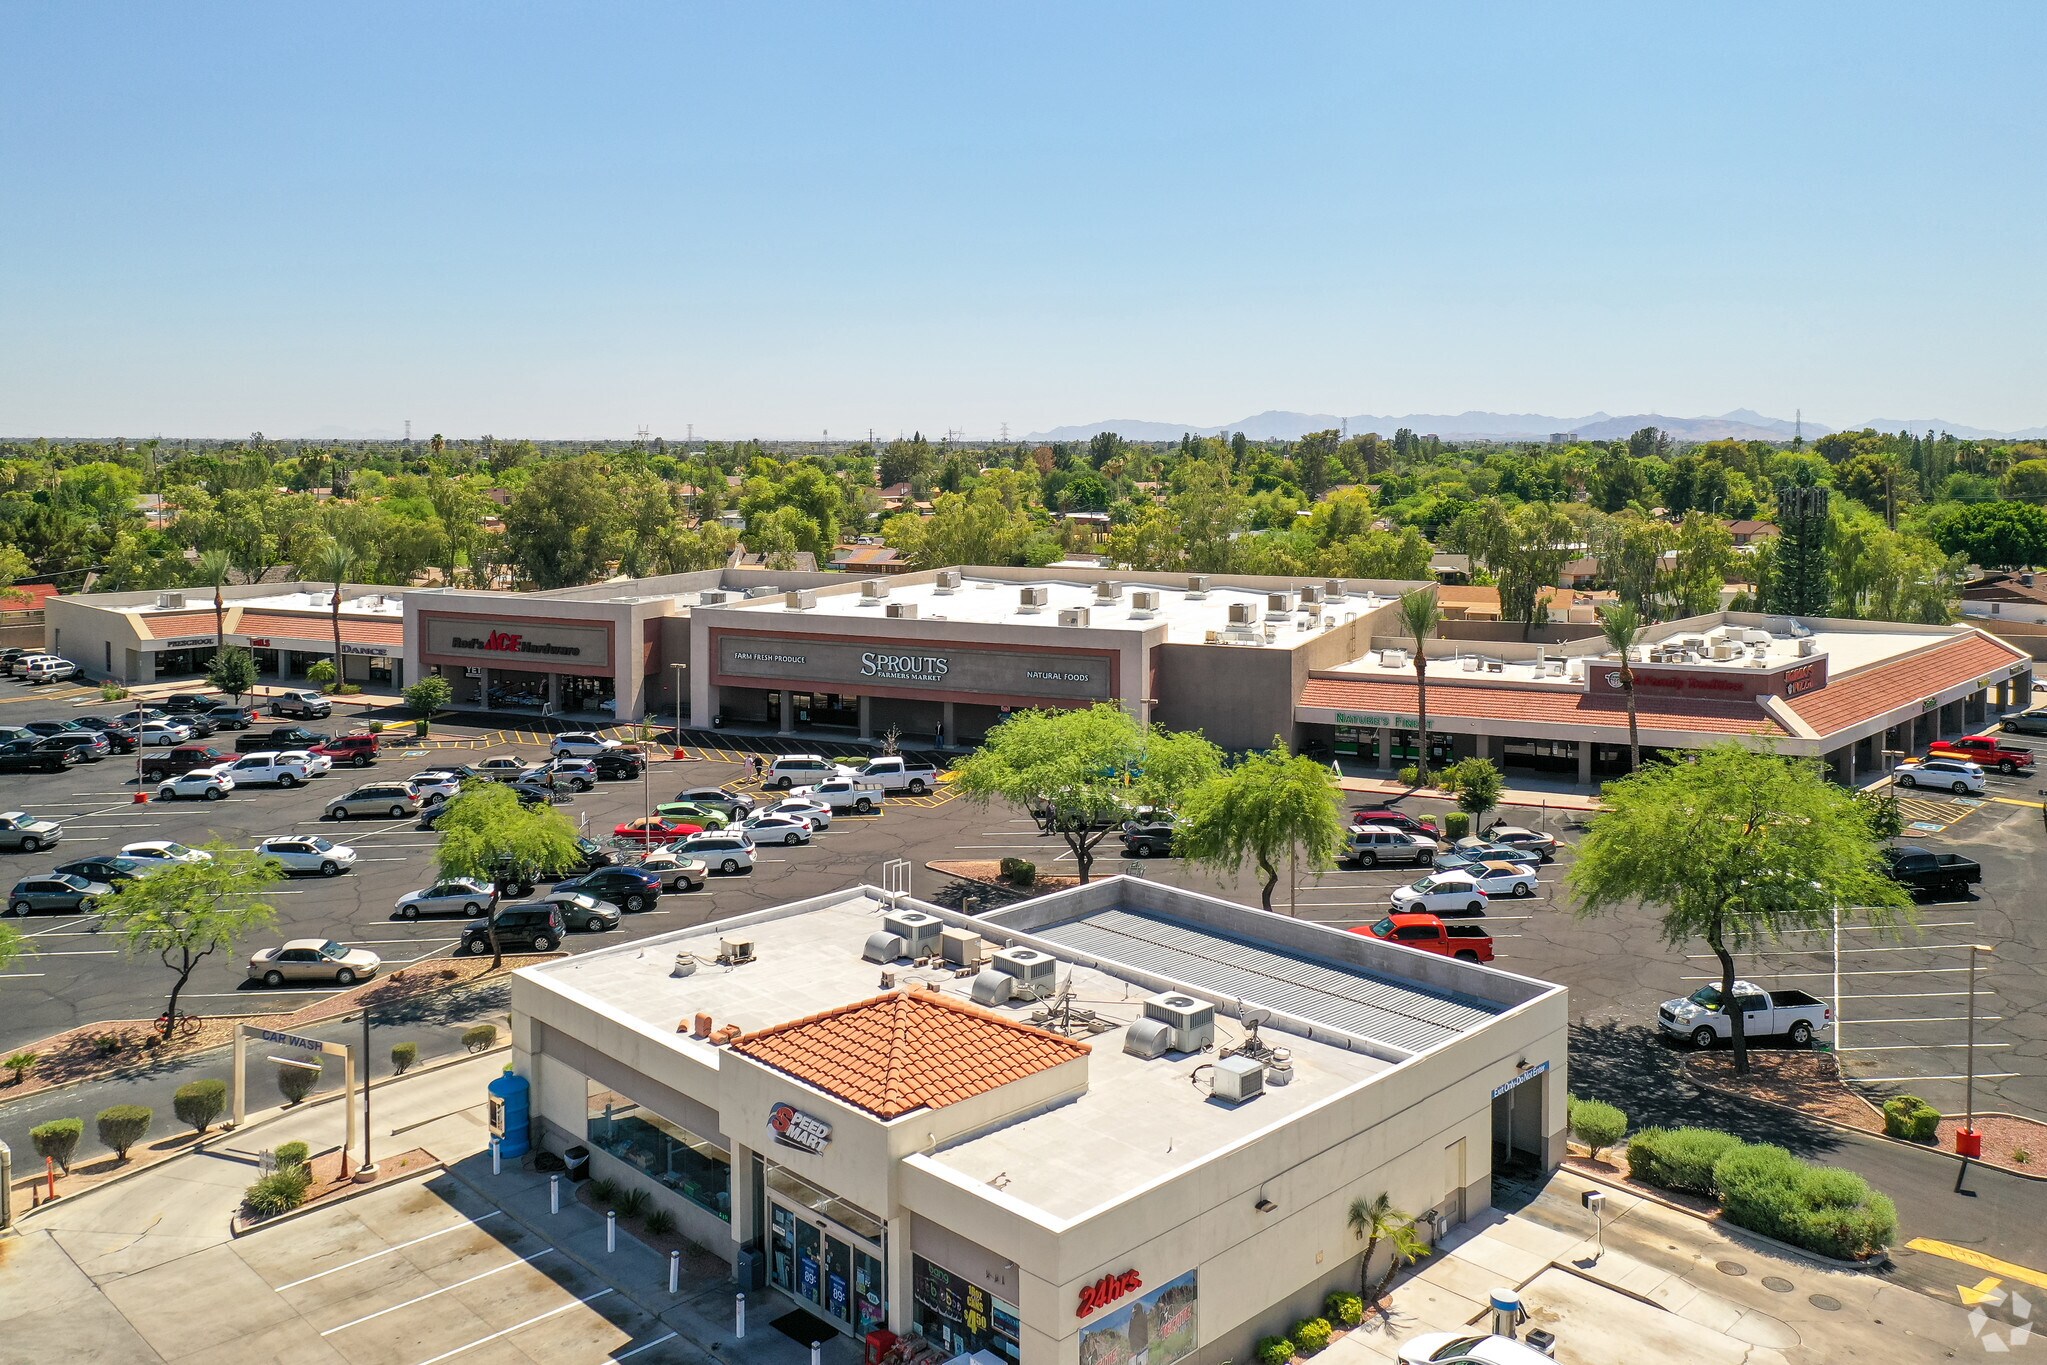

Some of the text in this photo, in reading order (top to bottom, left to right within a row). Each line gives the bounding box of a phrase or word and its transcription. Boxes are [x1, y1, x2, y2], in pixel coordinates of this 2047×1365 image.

[167, 638, 215, 648] PRESCHOOL
[341, 645, 388, 656] DANCE
[484, 629, 522, 652] ACE
[521, 641, 581, 656] Hardware
[734, 652, 752, 660] FARM
[774, 655, 806, 664] PRODUCE
[860, 652, 949, 676] SPROUTS
[466, 666, 482, 674] YET
[878, 671, 942, 682] FARMERS MARKET
[1026, 671, 1089, 682] NATURAL FOODS
[1335, 712, 1435, 729] NATURE'S FINET
[262, 1030, 323, 1052] CAR WASH
[1494, 1085, 1505, 1098] Exit
[1532, 1064, 1546, 1077] Enter
[771, 1106, 830, 1139] SPEED
[785, 1124, 829, 1151] MART
[928, 1262, 949, 1285] bang
[1076, 1268, 1143, 1319] 24hrs
